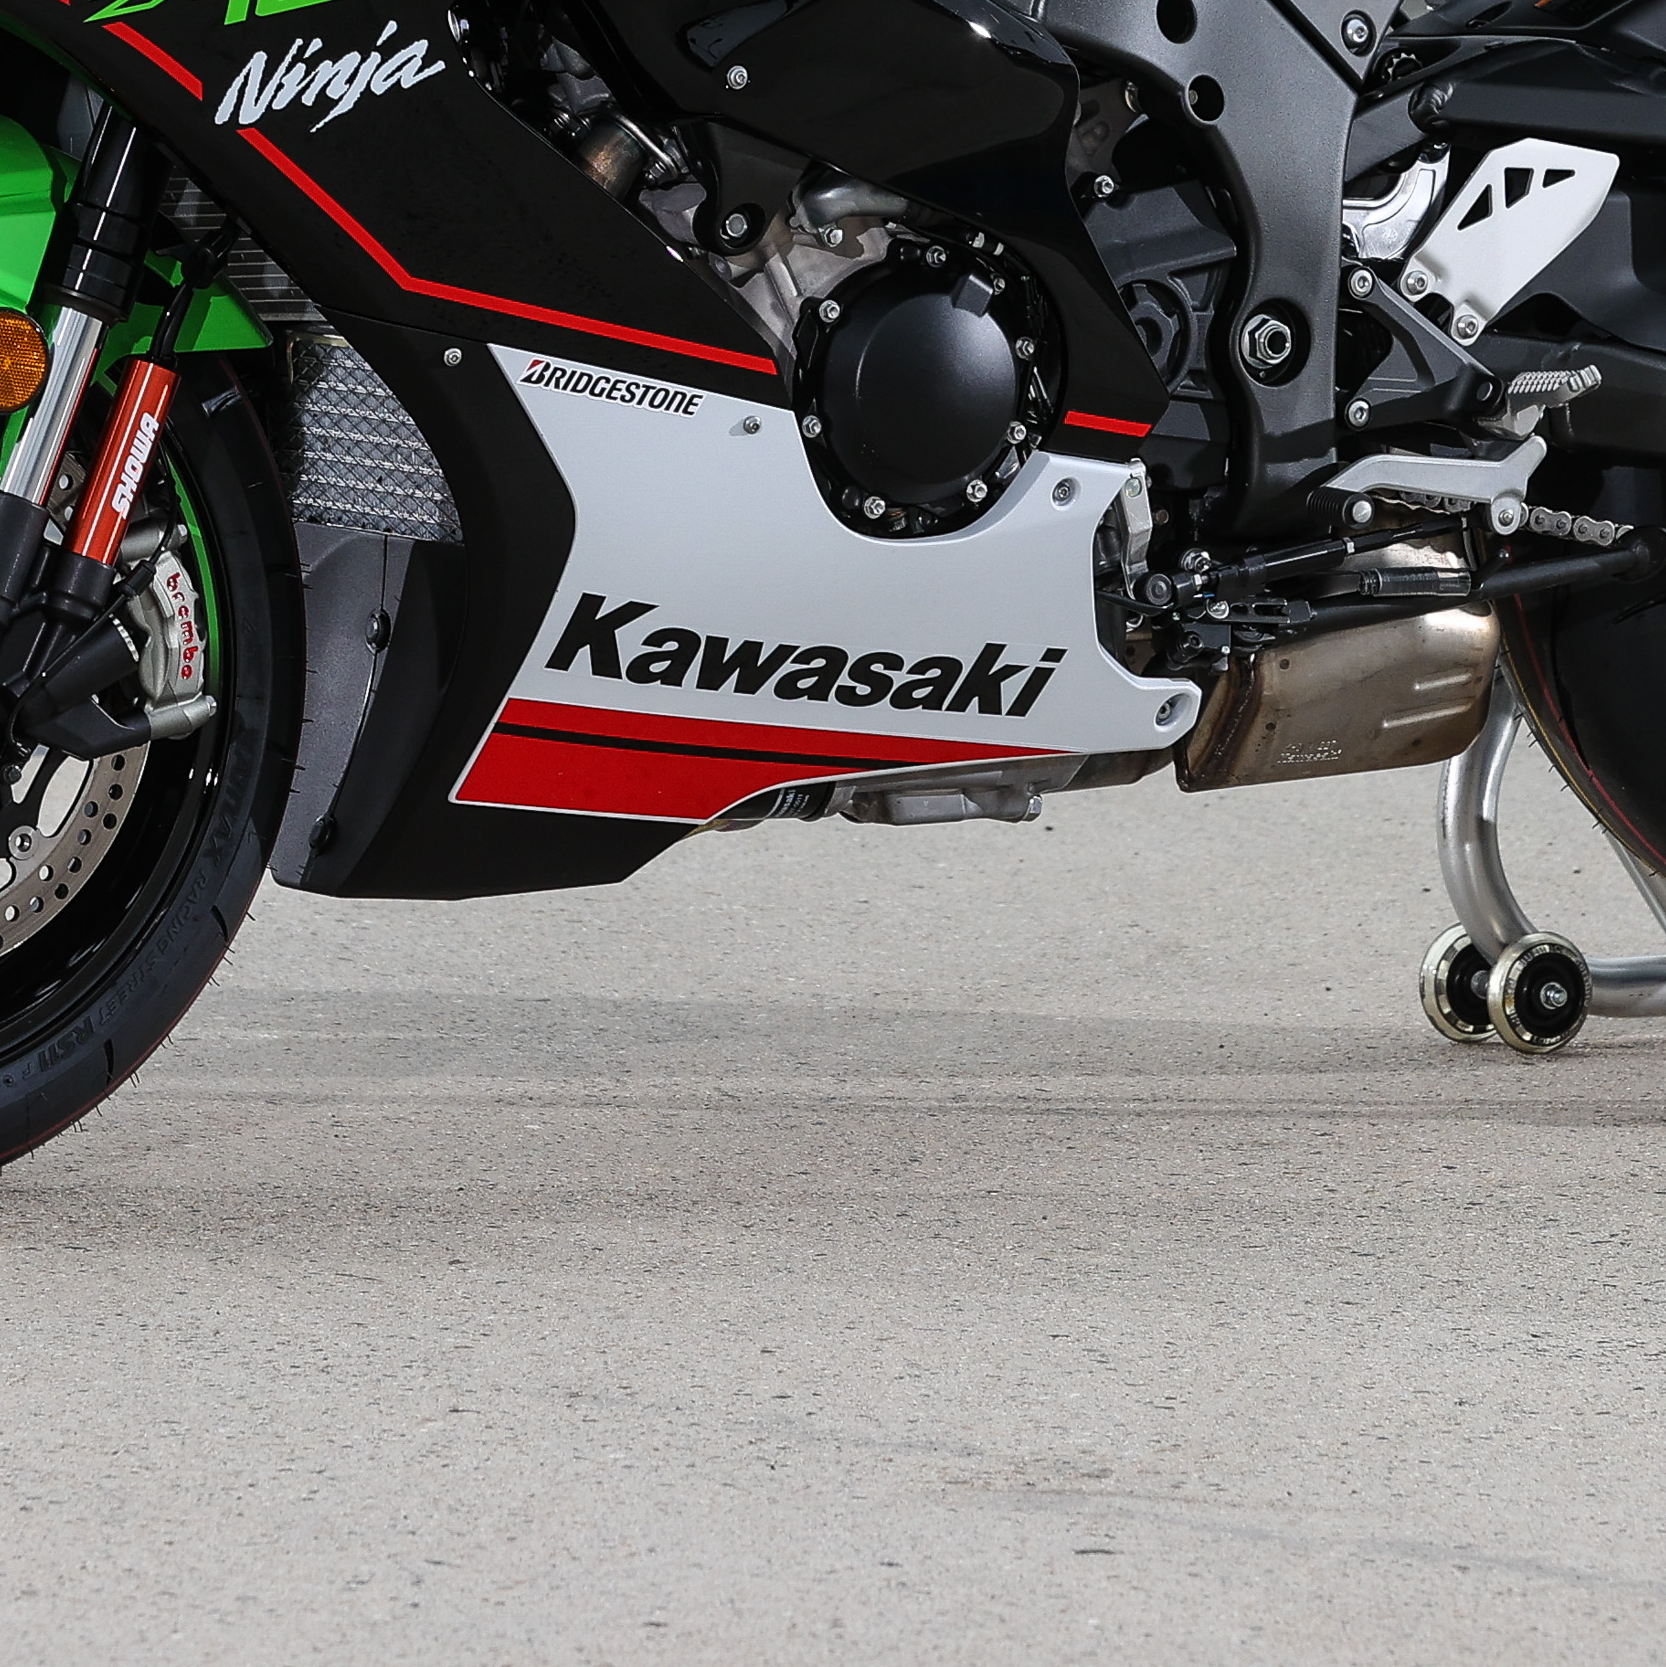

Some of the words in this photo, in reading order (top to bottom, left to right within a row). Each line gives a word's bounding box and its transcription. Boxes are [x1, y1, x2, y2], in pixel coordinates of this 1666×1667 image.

[214, 20, 446, 133] Ninja
[519, 359, 704, 416] BRIDGESTONE
[111, 411, 160, 520] SHOWA
[166, 571, 199, 681] brembo
[544, 592, 1068, 718] Kawasaki
[155, 869, 208, 954] RACING
[99, 952, 160, 1025] STREET
